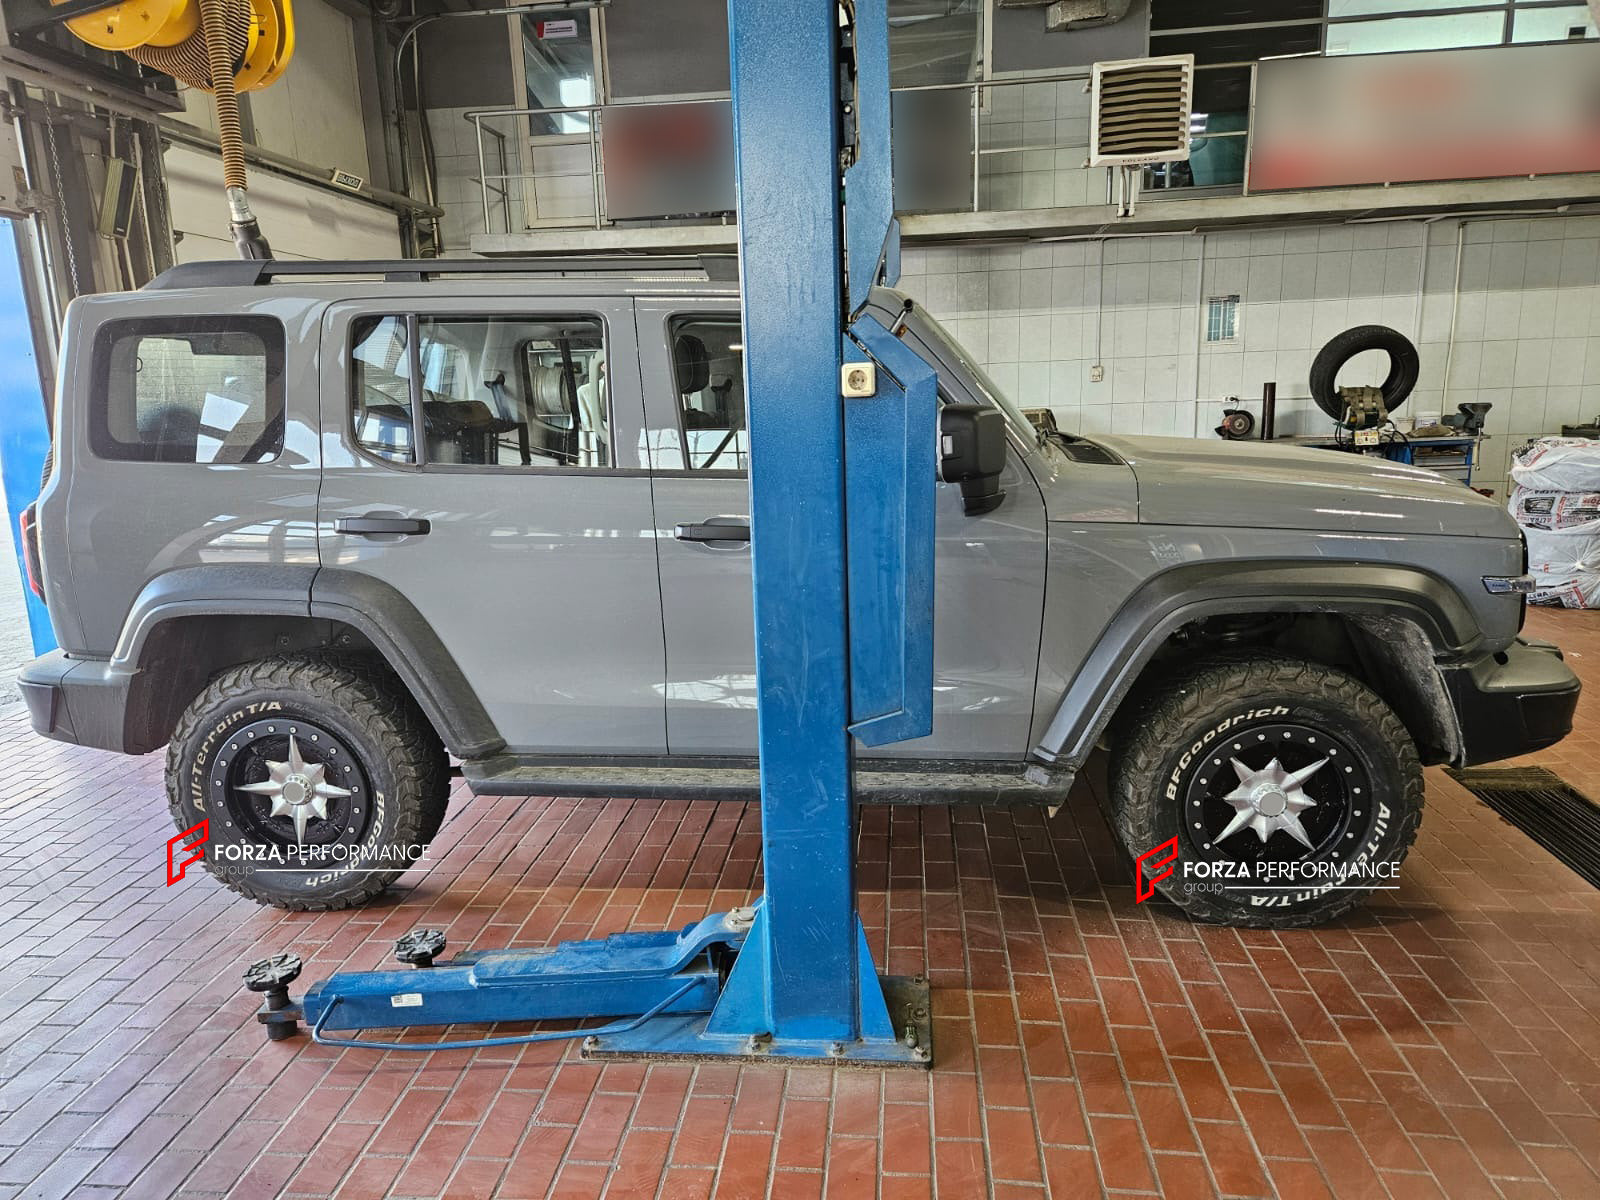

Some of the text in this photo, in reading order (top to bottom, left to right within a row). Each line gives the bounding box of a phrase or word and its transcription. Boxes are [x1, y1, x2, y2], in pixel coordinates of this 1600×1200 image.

[191, 701, 282, 812] All-Terrain T/A
[1166, 705, 1290, 800] BFGoodrich
[1250, 895, 1292, 908] T/A
